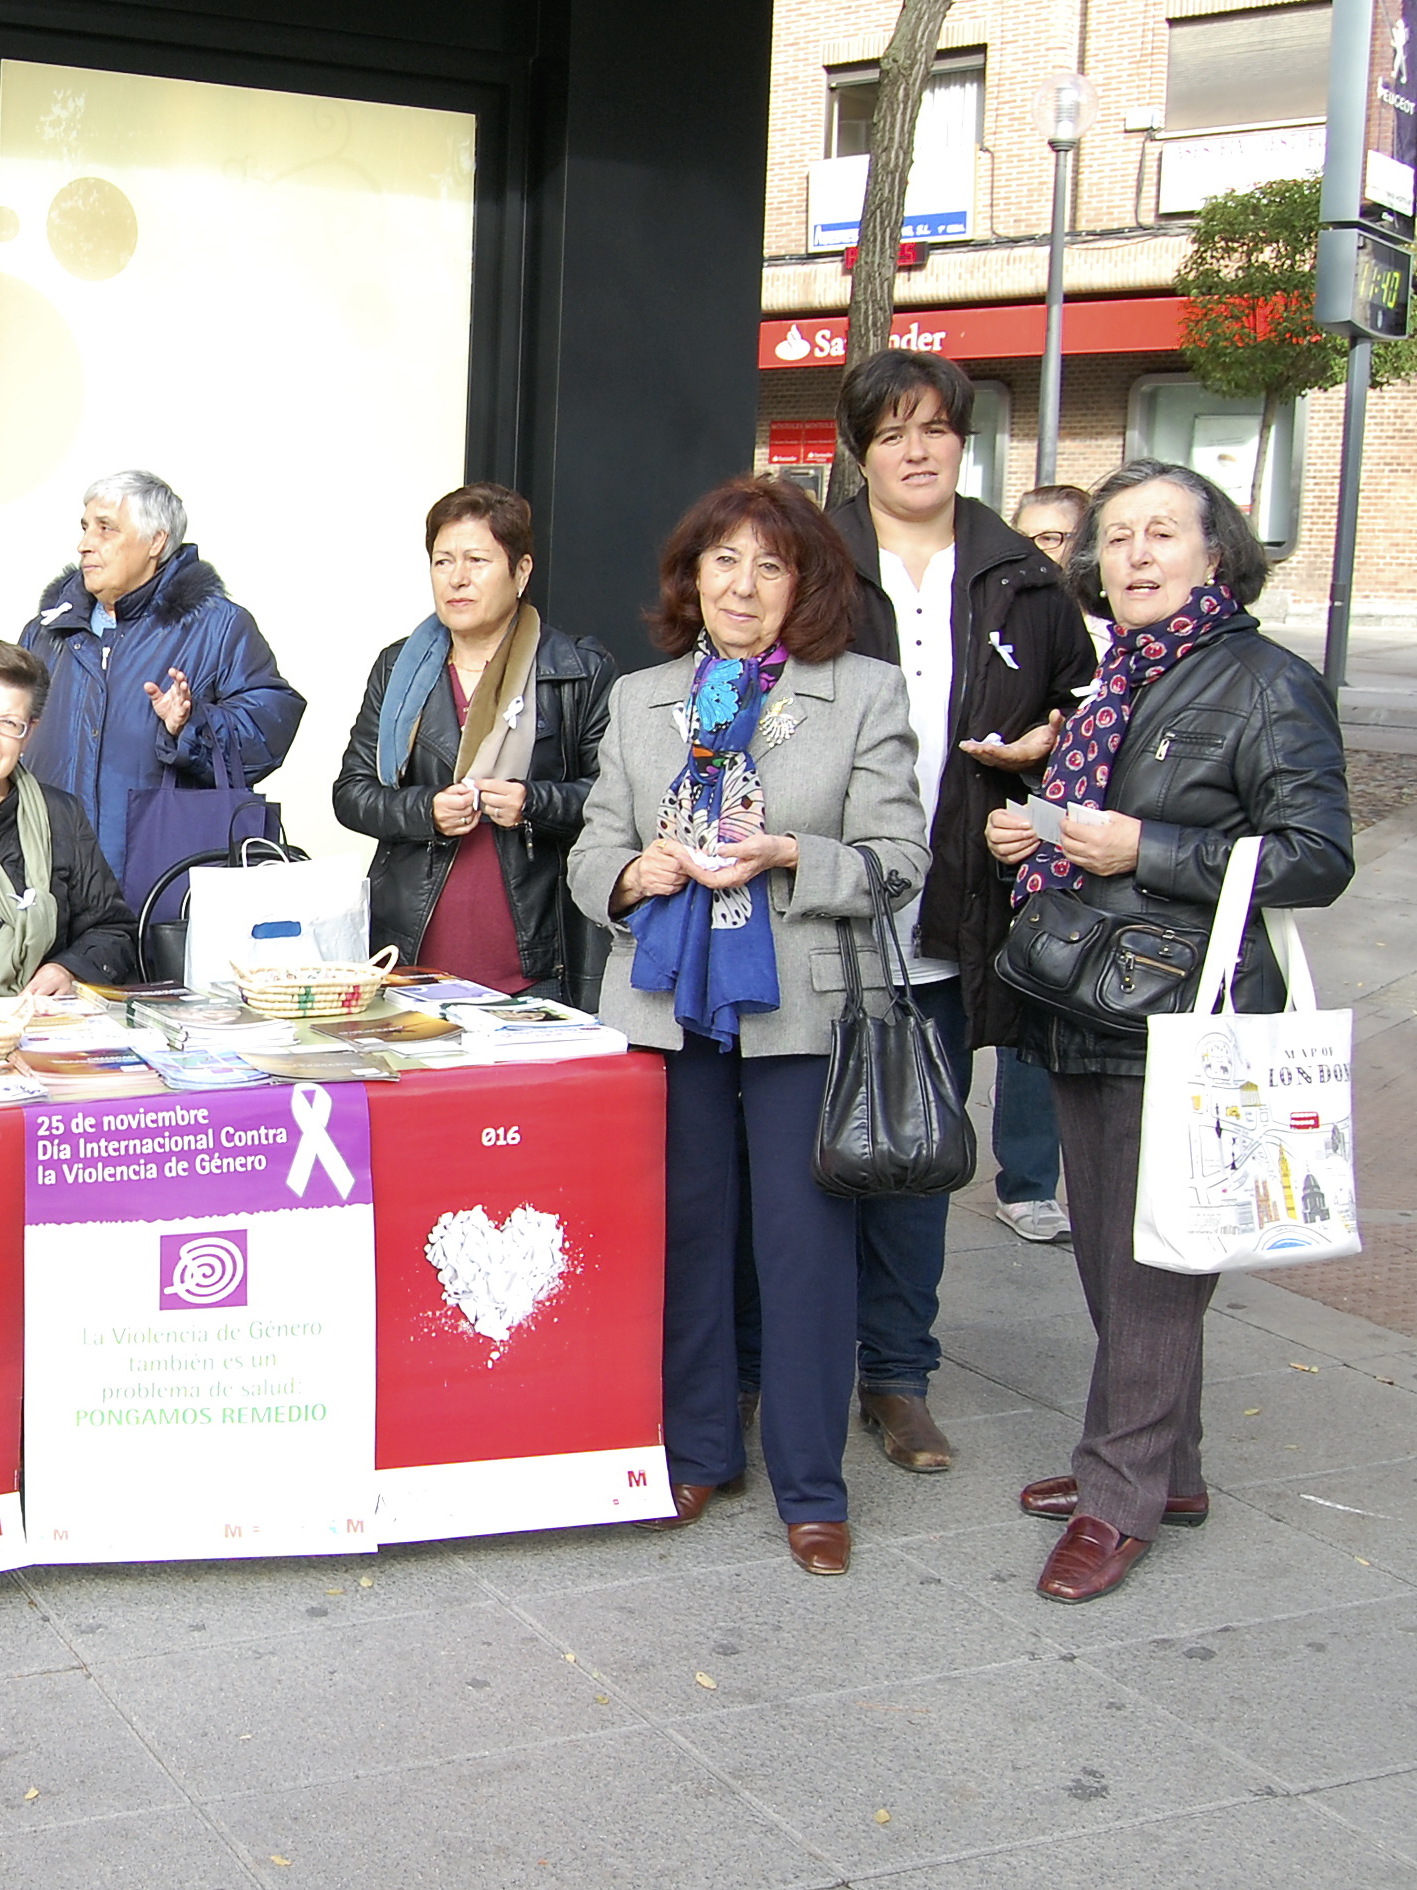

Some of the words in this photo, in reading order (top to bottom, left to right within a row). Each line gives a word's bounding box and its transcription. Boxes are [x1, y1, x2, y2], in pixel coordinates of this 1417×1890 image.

[1377, 76, 1416, 115] PEUGEOT
[1360, 263, 1402, 309] 11:40
[813, 321, 947, 358] Sander
[1284, 1047, 1317, 1059] MAP
[37, 1115, 65, 1136] 25
[70, 1112, 96, 1134] de
[102, 1104, 209, 1132] noviembre
[37, 1138, 71, 1161] Día
[79, 1128, 214, 1159] Internacional
[220, 1125, 288, 1148] Contra
[481, 1125, 522, 1147] 016
[37, 1165, 56, 1185] la
[62, 1158, 158, 1184] Violencia
[164, 1156, 189, 1178] de
[195, 1152, 267, 1175] Género
[82, 1327, 104, 1346] La
[112, 1325, 209, 1345] Violencia
[217, 1324, 241, 1342] de
[249, 1320, 323, 1340] Género
[129, 1353, 214, 1373] también
[223, 1354, 244, 1370] es
[251, 1353, 277, 1368] un
[102, 1382, 201, 1404] problema
[209, 1381, 233, 1399] de
[75, 1407, 213, 1428] PONGAMOS
[222, 1403, 328, 1425] REMEDIO
